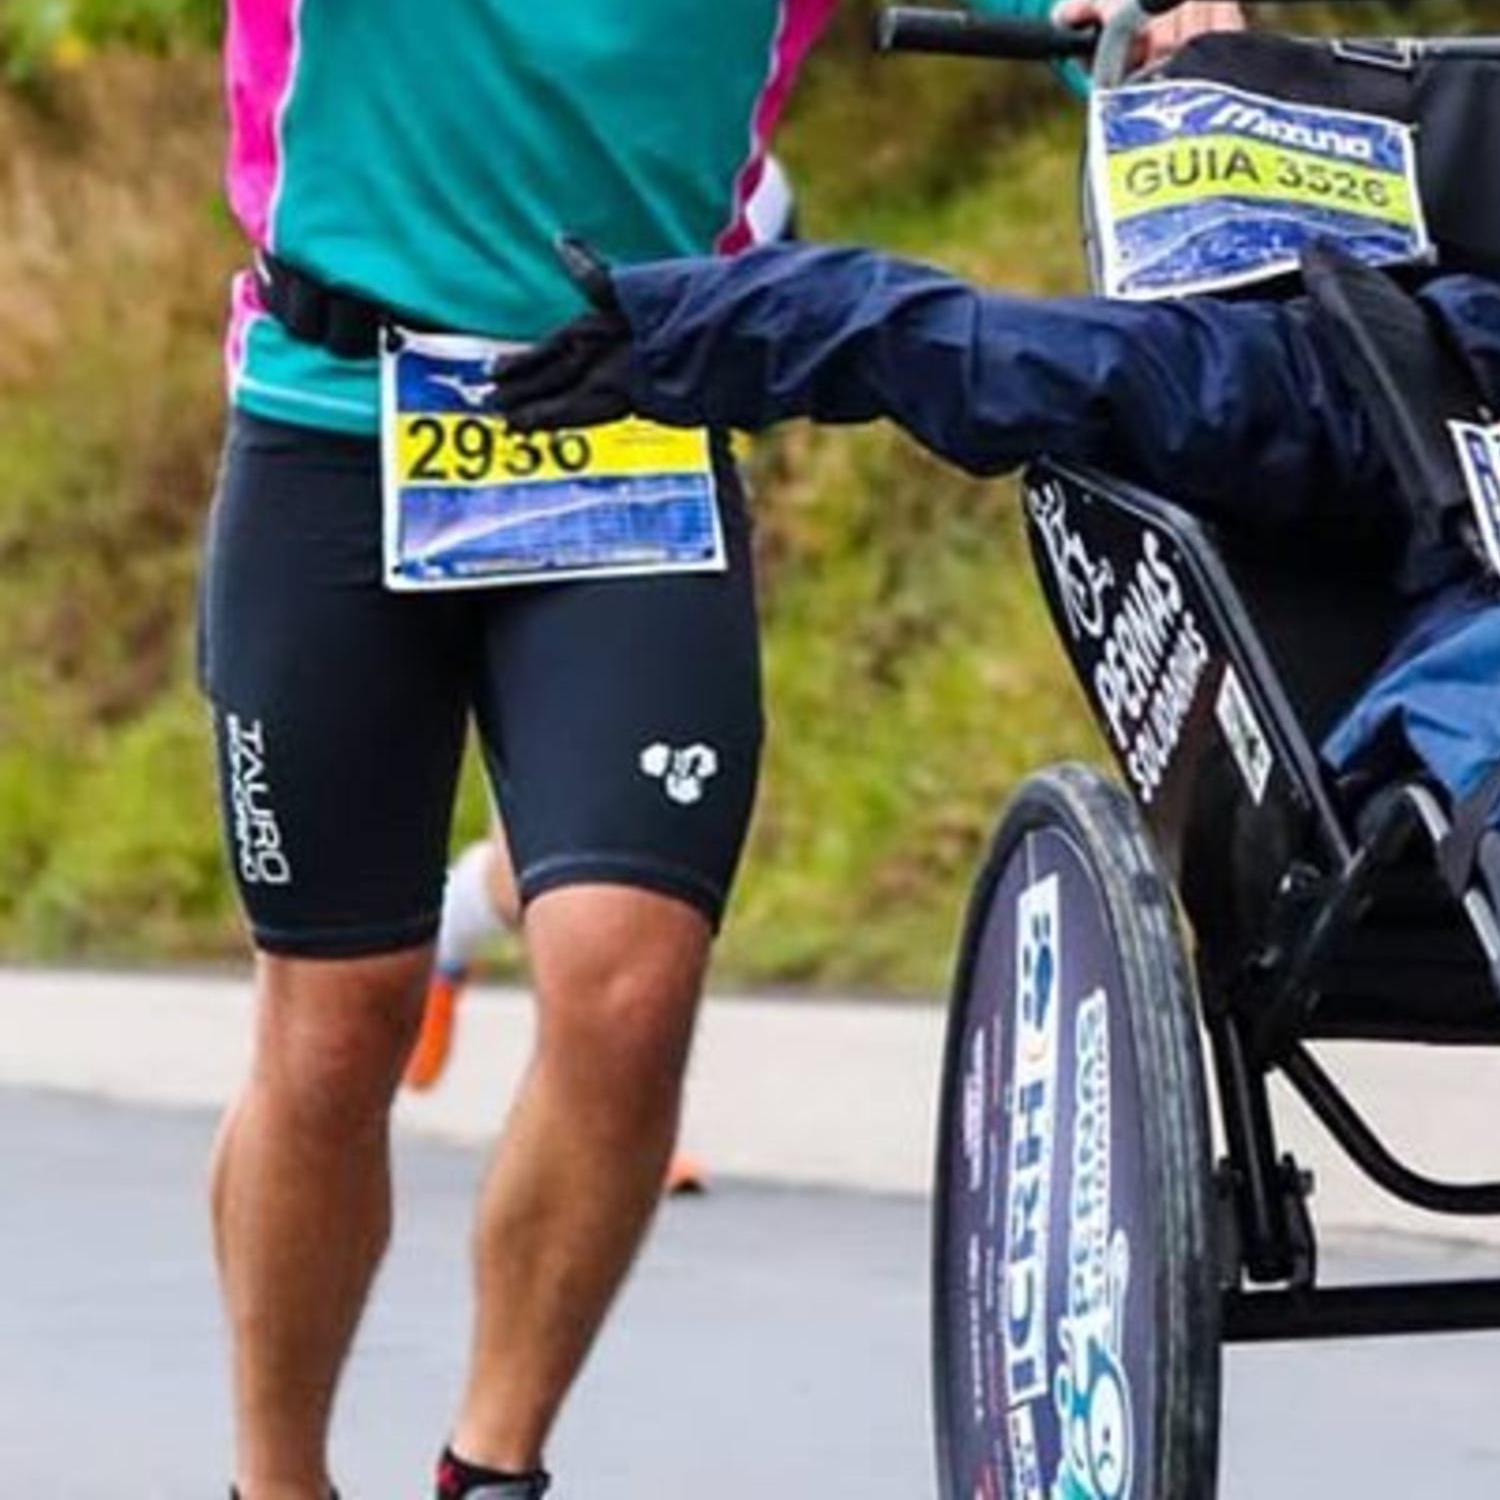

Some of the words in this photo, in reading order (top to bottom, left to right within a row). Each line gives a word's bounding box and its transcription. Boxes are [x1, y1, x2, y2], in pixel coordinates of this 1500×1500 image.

[1125, 148, 1261, 198] GUIA
[1277, 155, 1392, 208] 3526
[240, 719, 291, 884] TAURO
